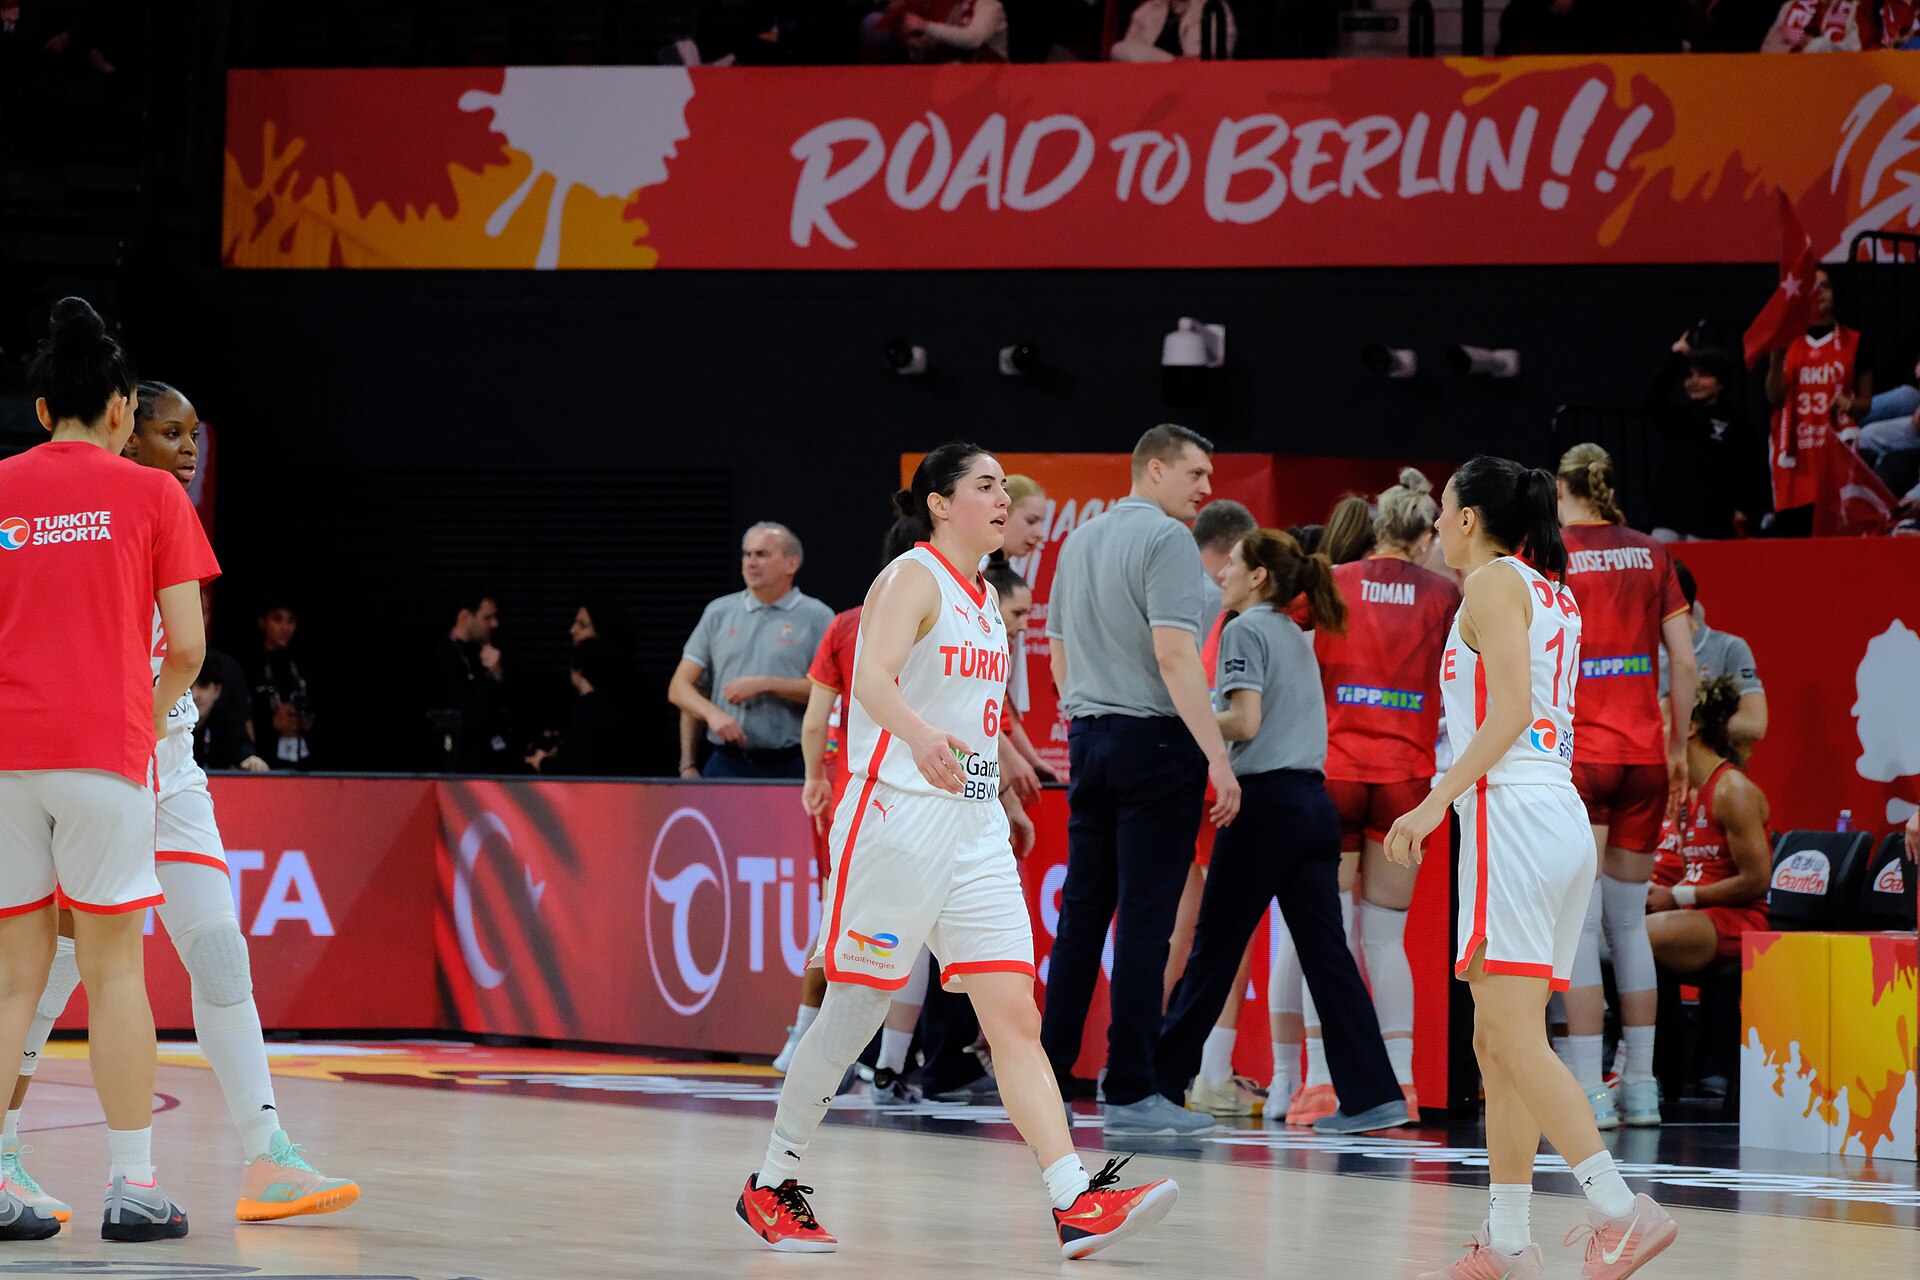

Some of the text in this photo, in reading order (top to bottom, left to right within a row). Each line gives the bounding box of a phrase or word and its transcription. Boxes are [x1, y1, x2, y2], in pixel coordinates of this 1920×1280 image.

[790, 78, 1654, 249] ROAD TO BERLIN!!
[1797, 392, 1828, 415] 33
[1567, 546, 1654, 575] JOSEPOVITS
[1361, 579, 1416, 606] TOMAN
[940, 640, 1010, 683] TÜRKİ
[983, 698, 998, 738] 6
[842, 953, 895, 970] TotalEnergies
